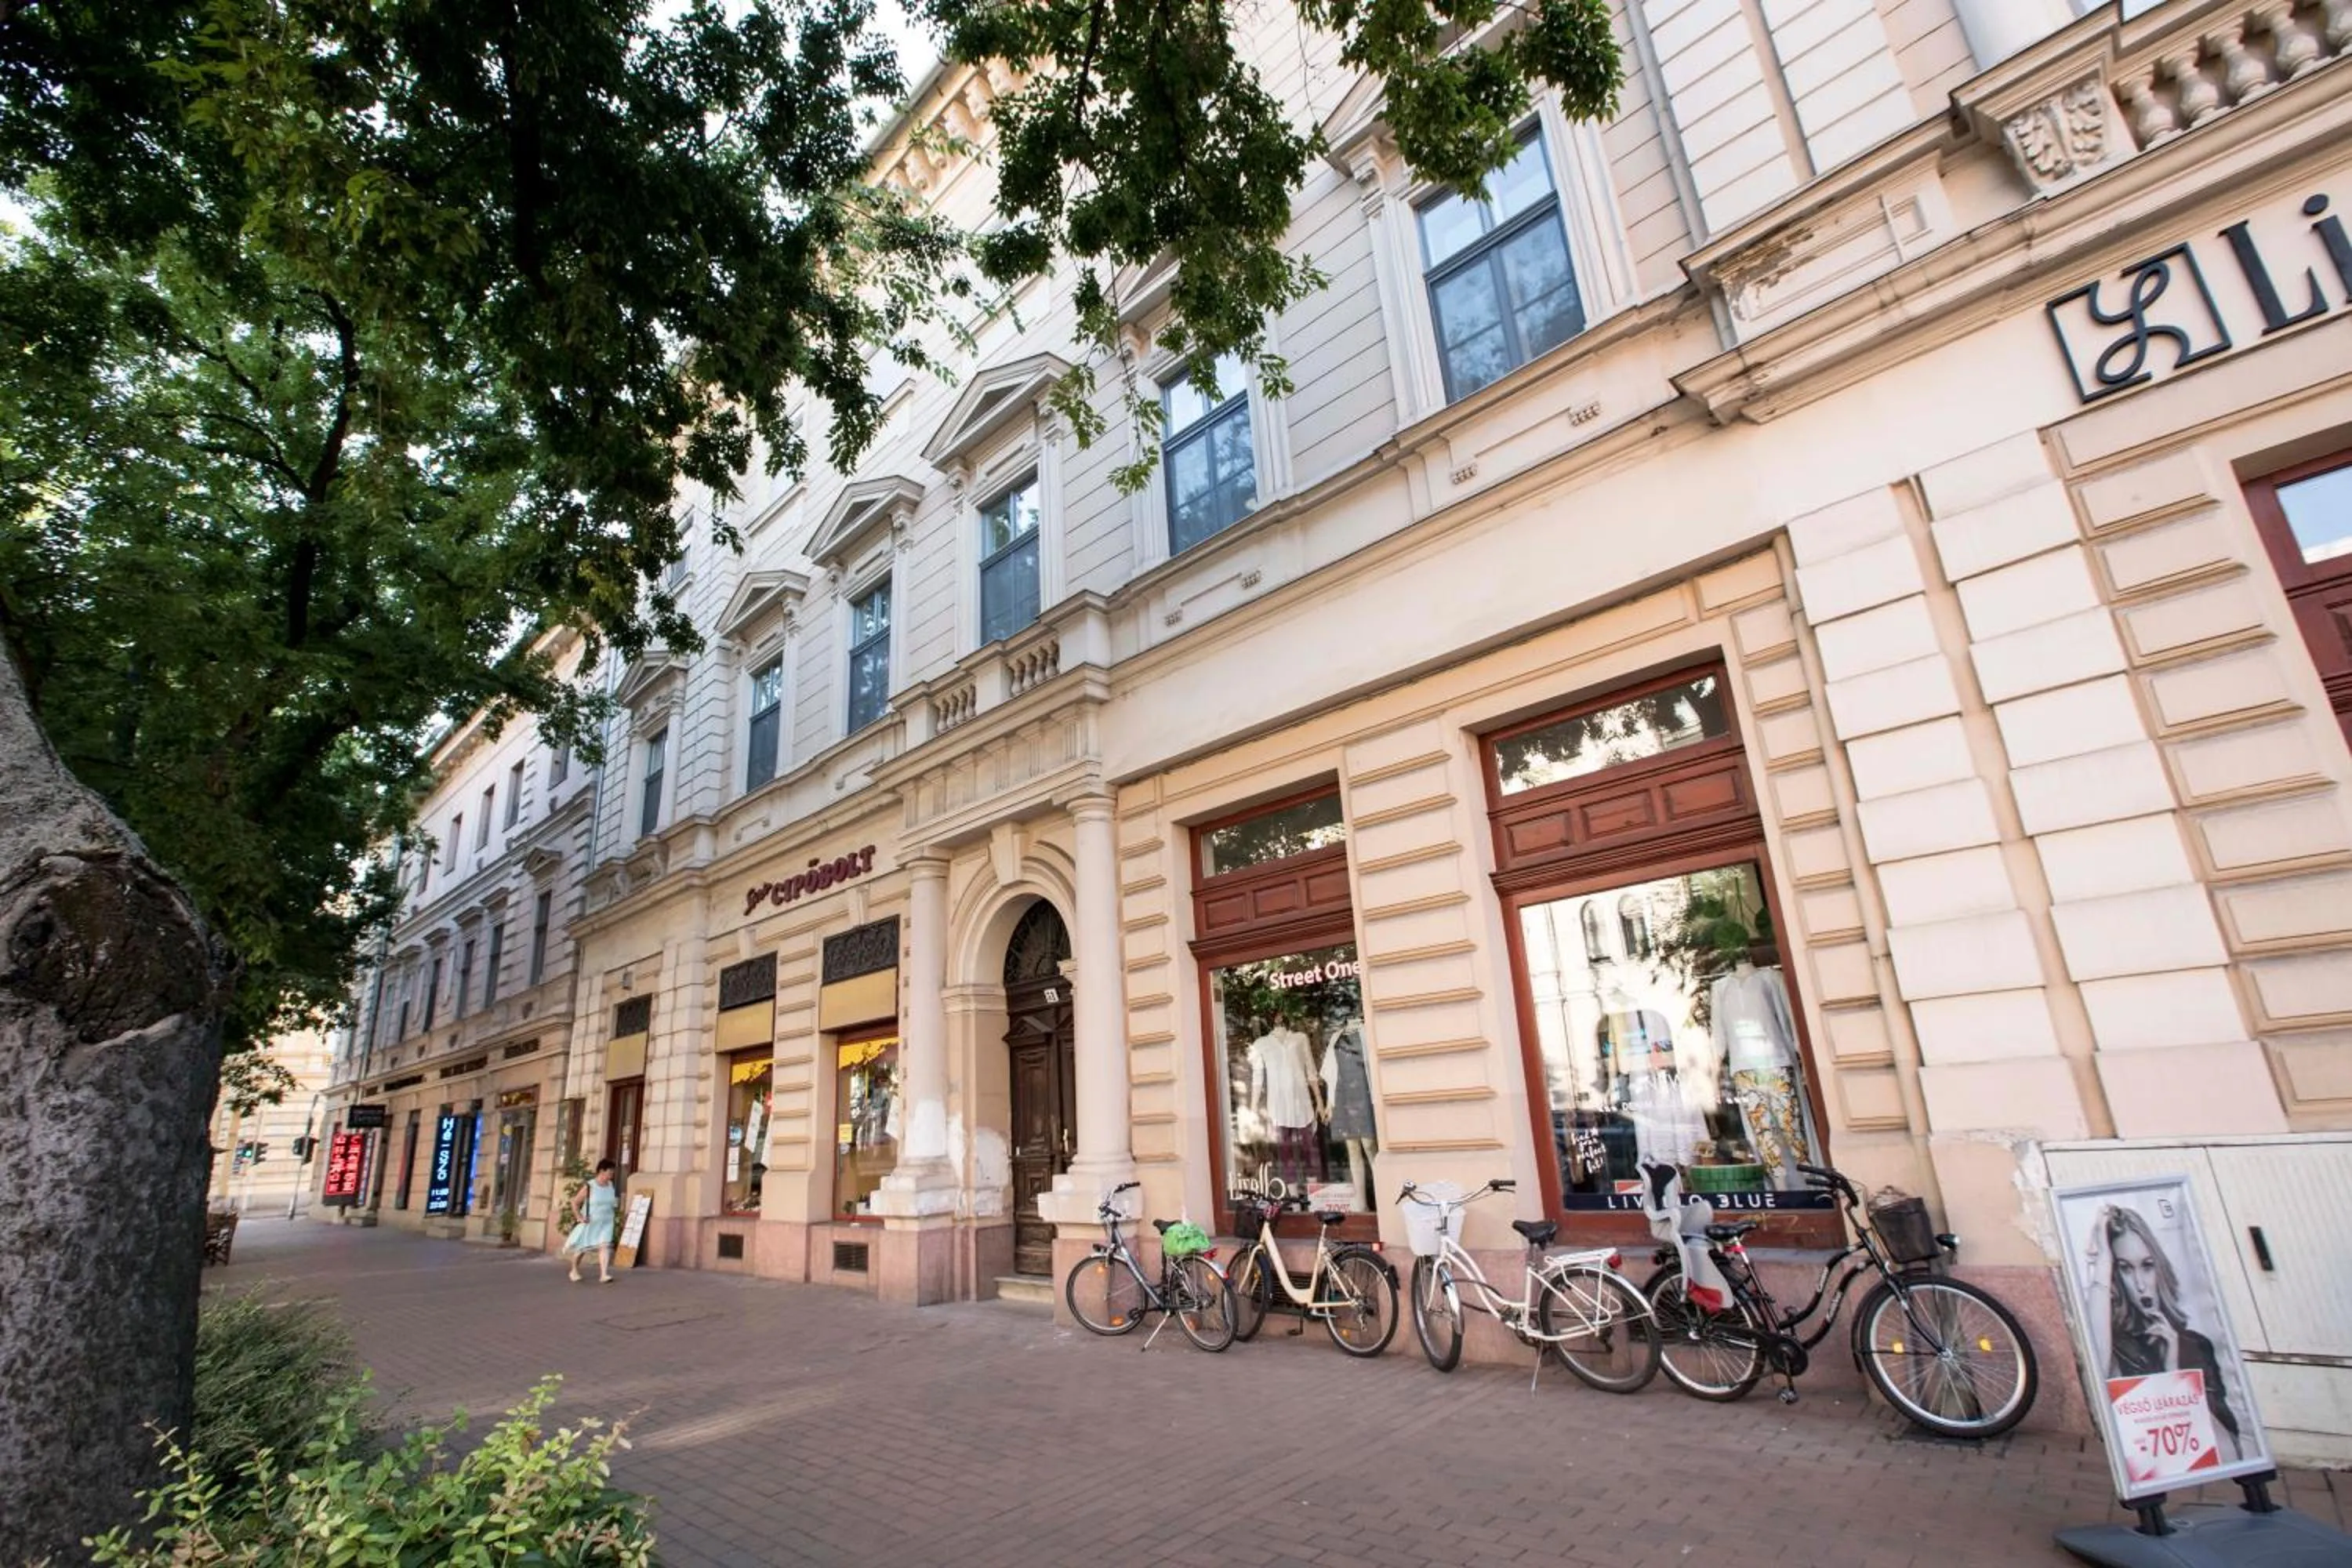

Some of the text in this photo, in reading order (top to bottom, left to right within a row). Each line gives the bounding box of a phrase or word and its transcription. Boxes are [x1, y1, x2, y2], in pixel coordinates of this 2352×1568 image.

[771, 844, 877, 906] CIPŐBOLT
[1269, 960, 1361, 989] Street One
[1607, 1193, 1777, 1208] LIVLLO BLUE
[2140, 1422, 2200, 1457] -70%
